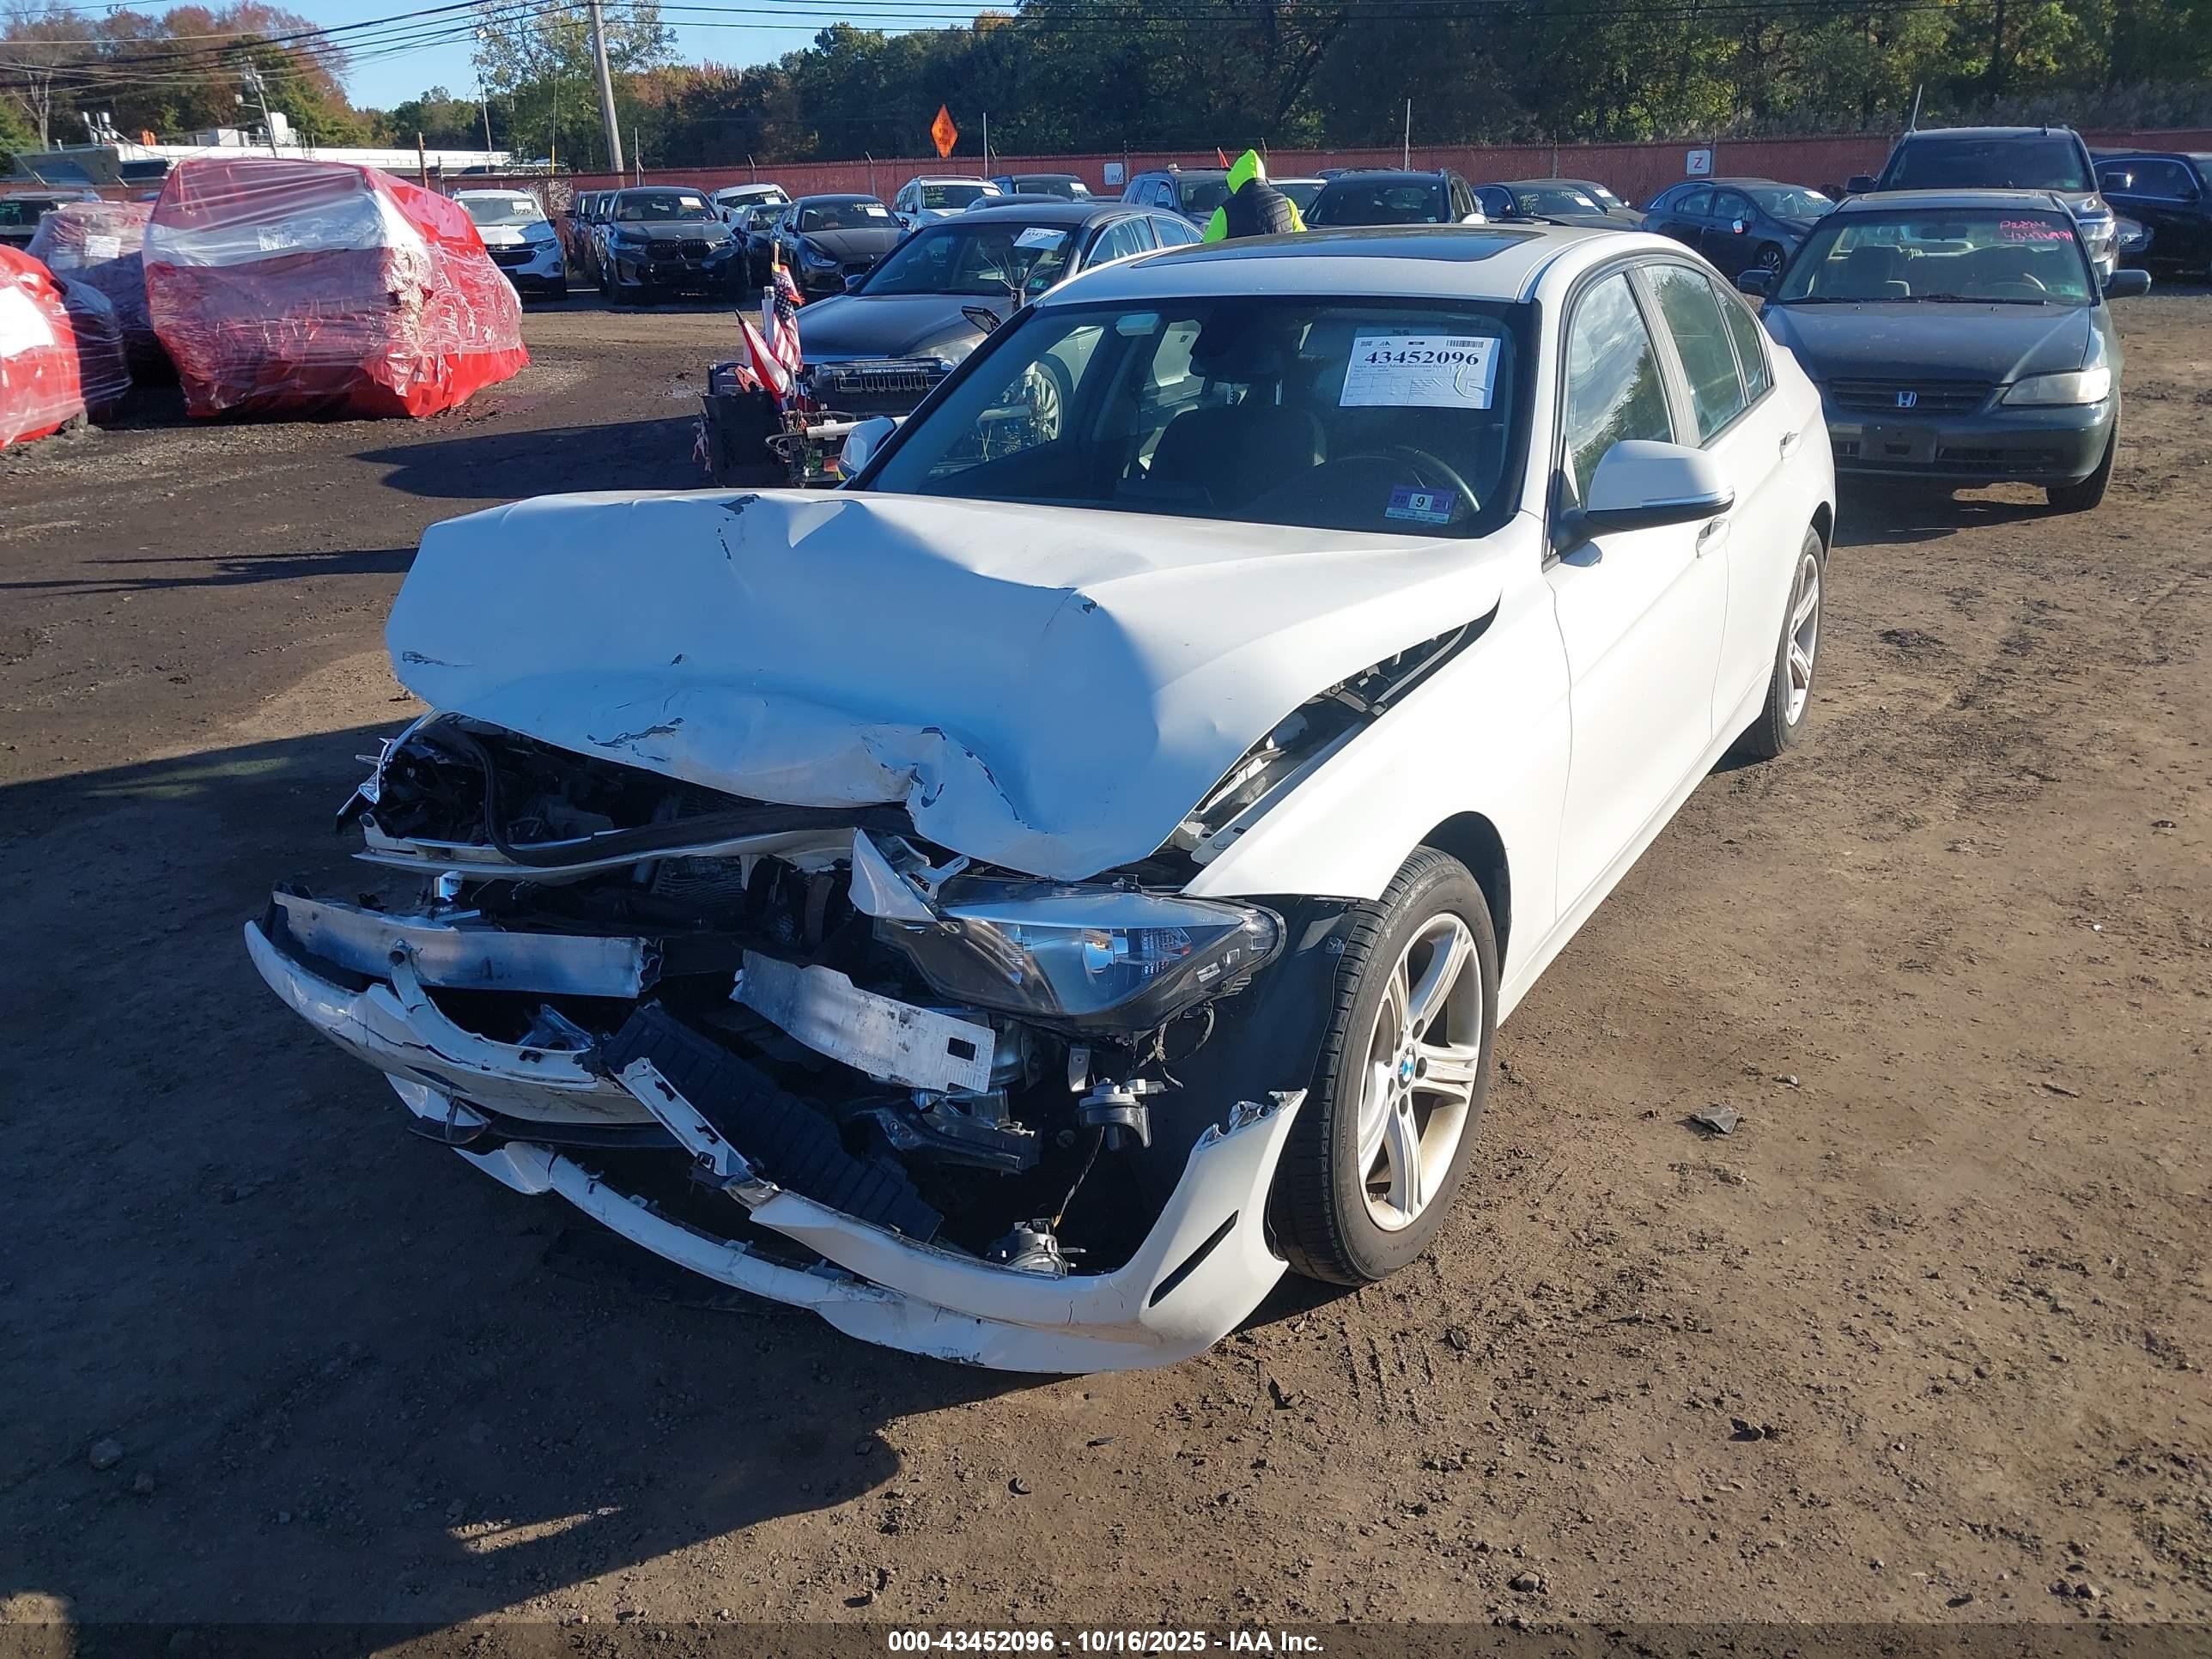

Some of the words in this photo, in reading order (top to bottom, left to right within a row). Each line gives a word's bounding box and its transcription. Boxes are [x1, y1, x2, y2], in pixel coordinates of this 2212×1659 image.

[1693, 156, 1704, 169] Z
[1364, 350, 1480, 366] 43452096
[1415, 495, 1426, 508] 9
